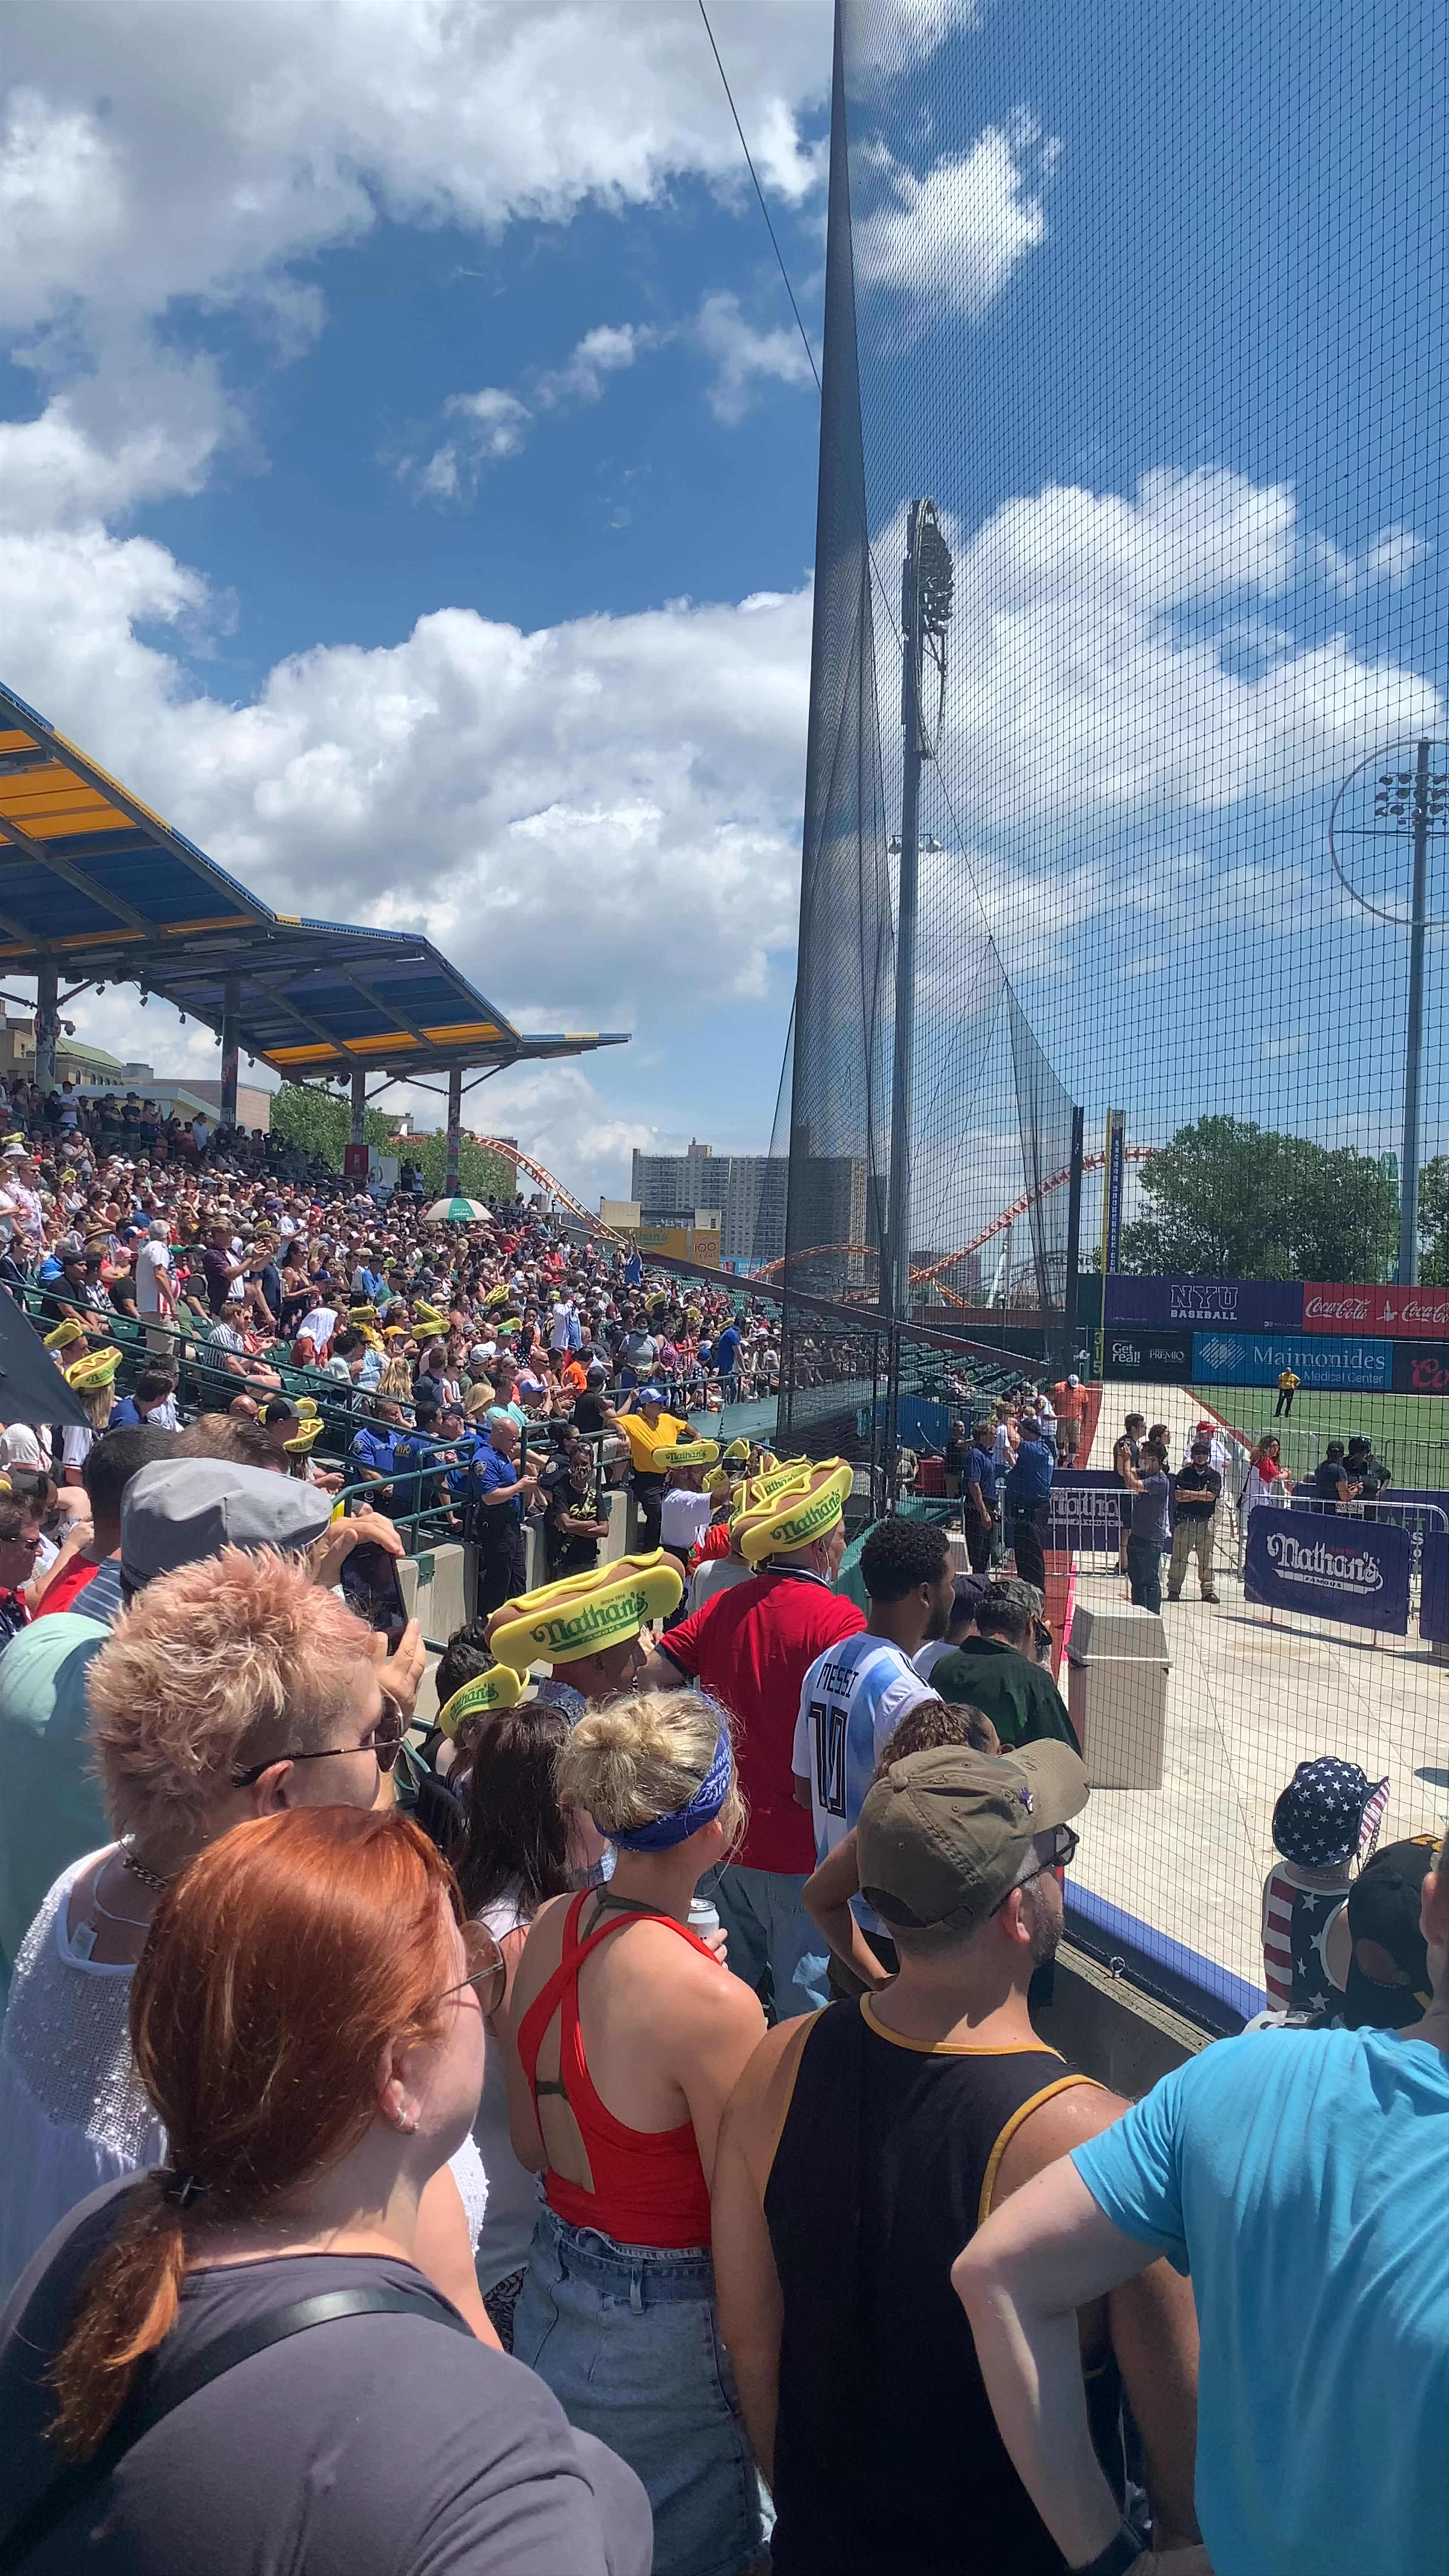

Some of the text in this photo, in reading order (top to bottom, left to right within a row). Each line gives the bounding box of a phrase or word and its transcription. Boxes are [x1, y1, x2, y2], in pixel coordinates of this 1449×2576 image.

[695, 1243, 716, 1253] 100
[1171, 1285, 1238, 1310] NYU
[1171, 1310, 1237, 1320] BASEBALL
[1112, 1343, 1133, 1354] Get
[1149, 1350, 1184, 1360] PREMIO
[1112, 1352, 1140, 1363] real!
[1253, 1346, 1385, 1369] Maimonides
[1304, 1371, 1383, 1383] Medical Center
[770, 1489, 841, 1540] Nathan's
[1267, 1533, 1380, 1583] Nathan's
[1305, 1576, 1342, 1588] FAMOUS
[529, 1591, 648, 1646] Nathan's
[817, 1663, 859, 1698] MESSI
[808, 1701, 848, 1819] 10
